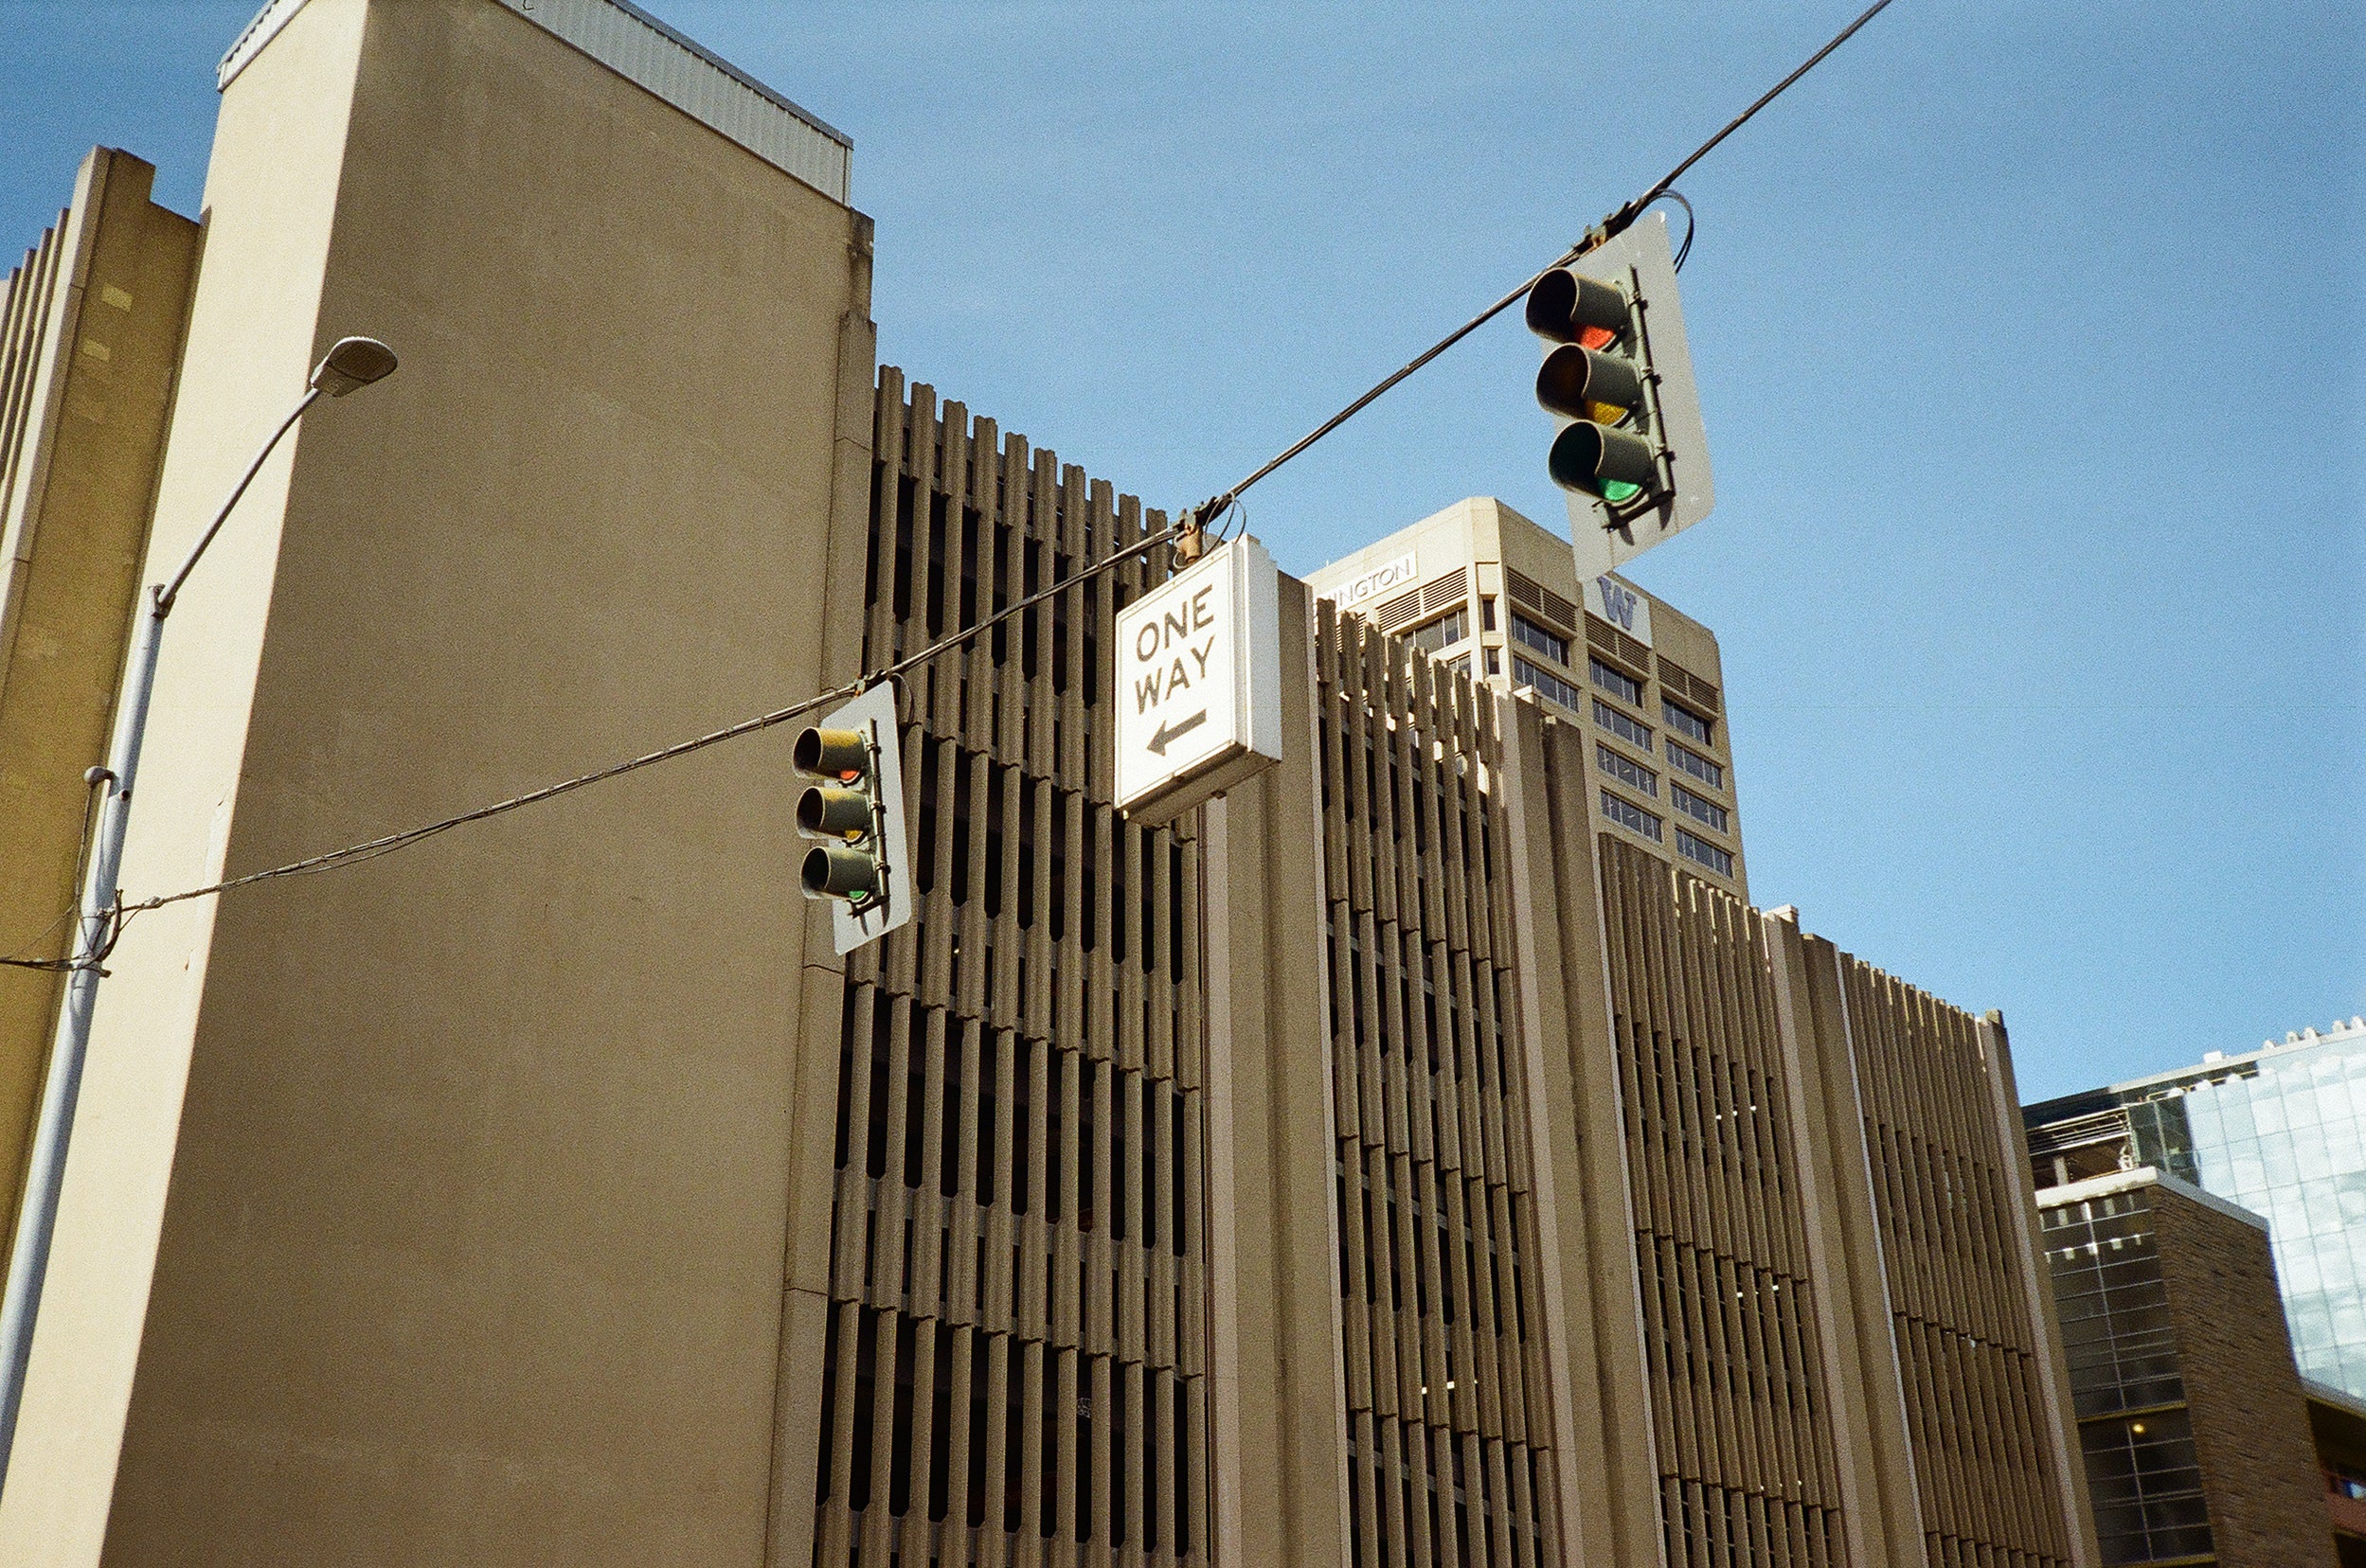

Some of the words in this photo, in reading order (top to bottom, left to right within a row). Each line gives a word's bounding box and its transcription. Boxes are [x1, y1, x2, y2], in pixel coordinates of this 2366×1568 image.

[1328, 559, 1409, 607] INGTON
[1597, 576, 1637, 631] W
[1137, 583, 1214, 663] ONE
[1135, 633, 1216, 716] WAY
